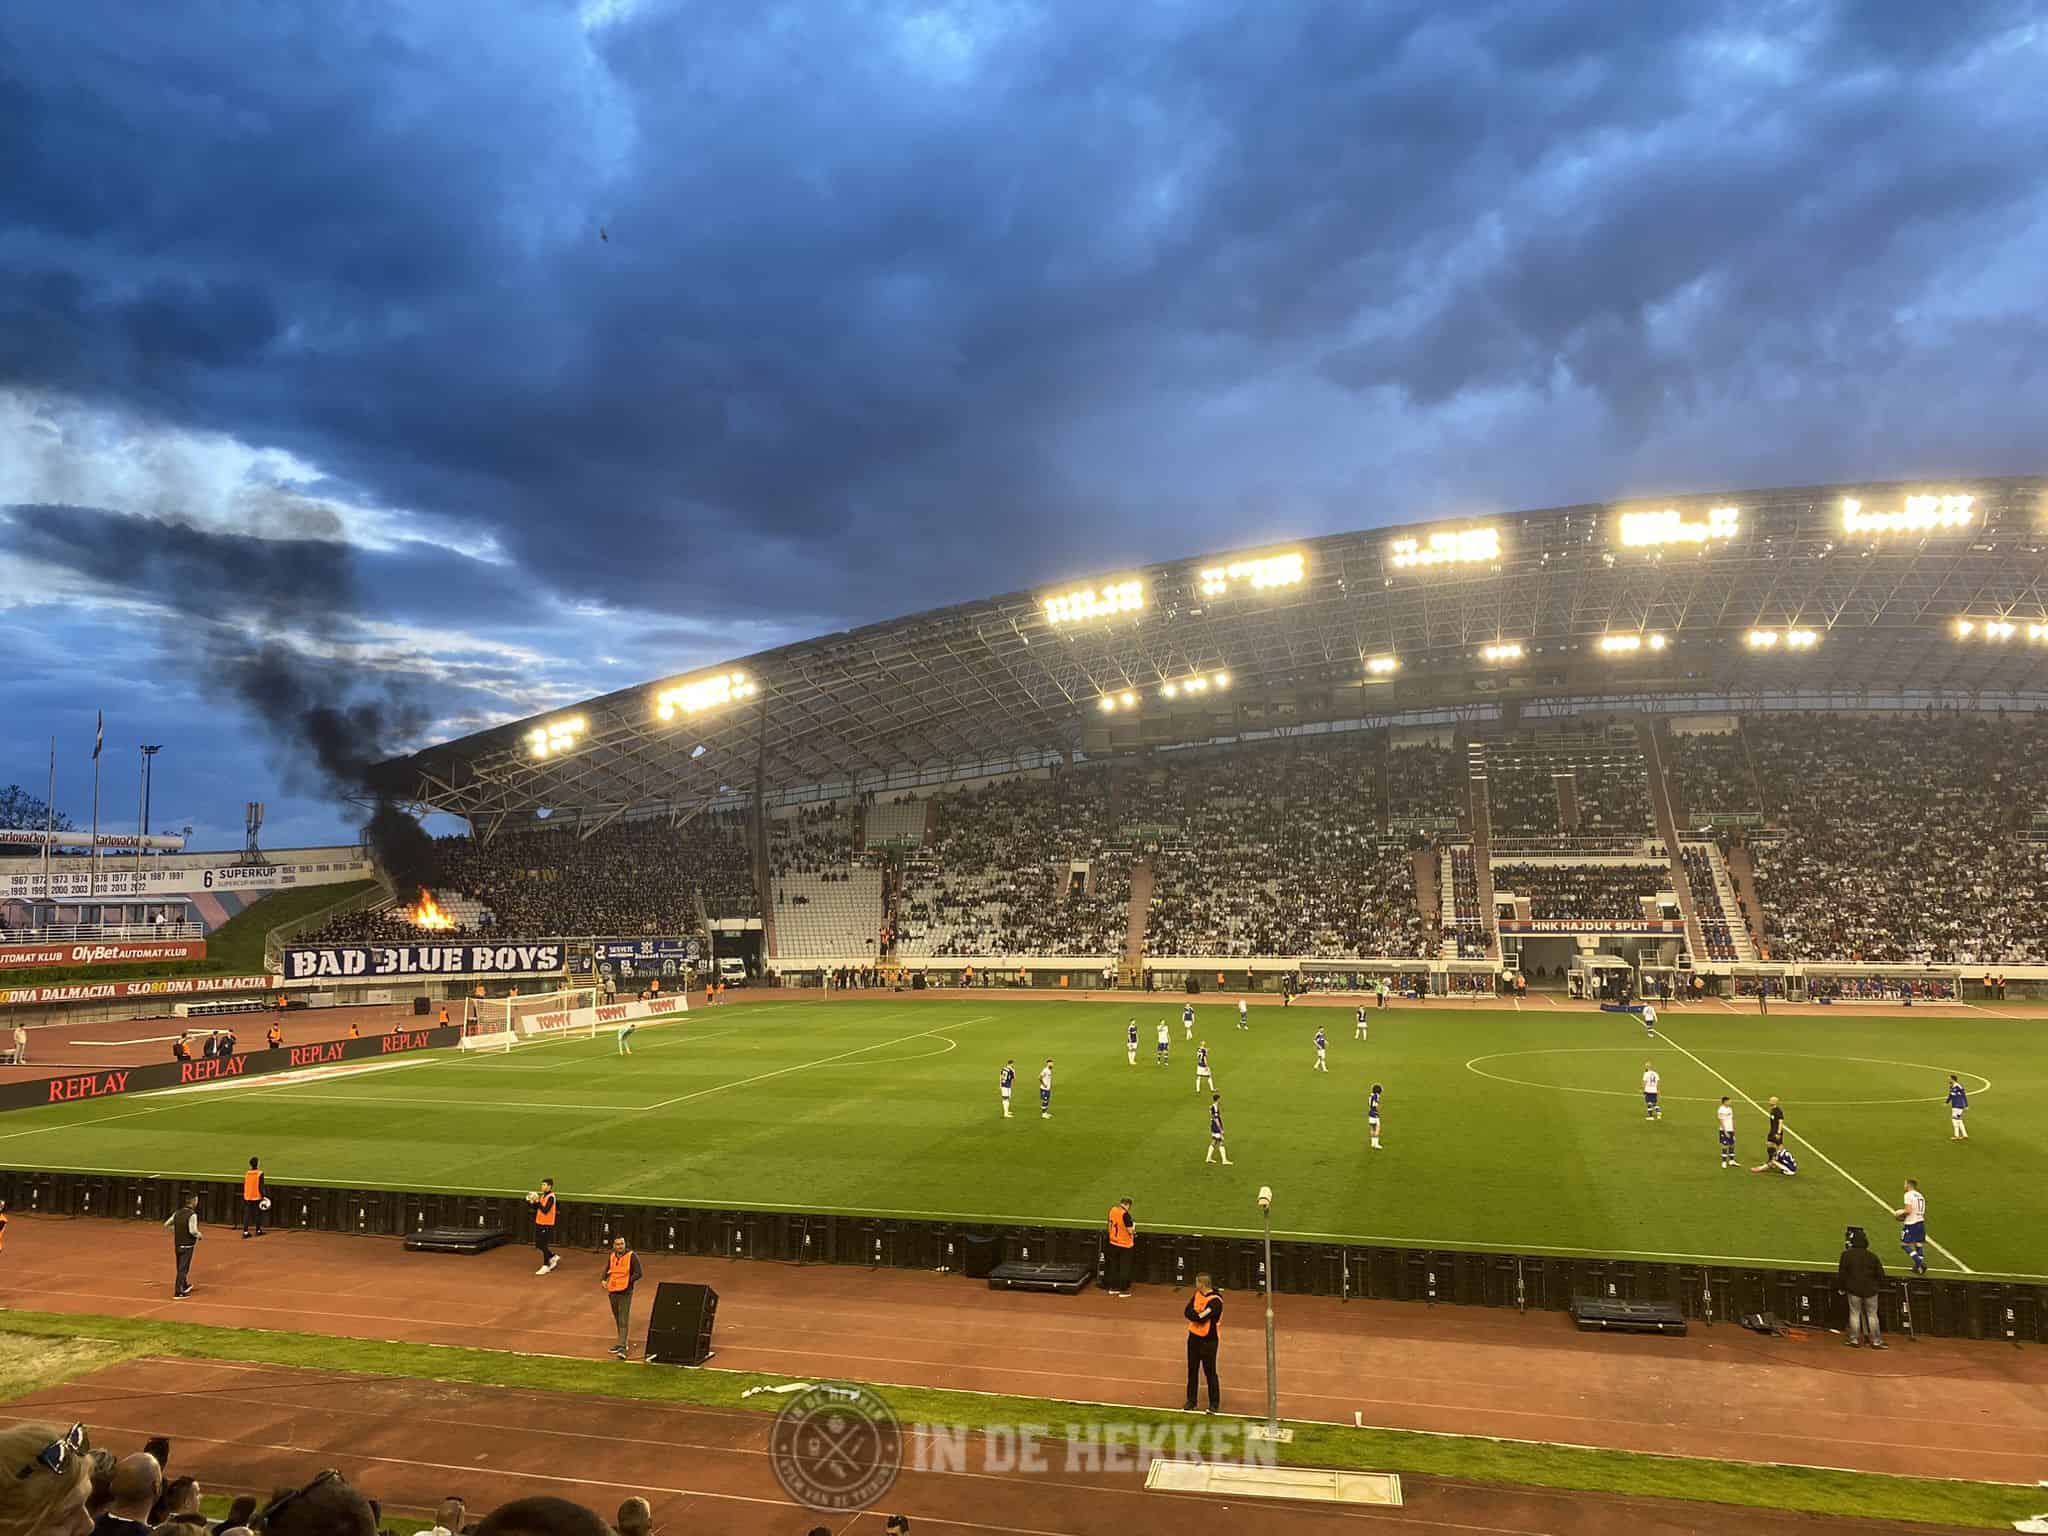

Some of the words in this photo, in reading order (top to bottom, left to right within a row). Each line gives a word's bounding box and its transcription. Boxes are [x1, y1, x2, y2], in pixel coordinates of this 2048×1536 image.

[0, 832, 46, 844] arlovačko
[11, 876, 28, 885] 1967
[72, 874, 88, 883] 1974
[94, 873, 108, 883] 976
[203, 870, 213, 888] 6
[219, 867, 276, 879] SUPERKUP
[95, 884, 108, 893] 010
[1532, 921, 1558, 931] HNK
[1560, 921, 1613, 931] HAJDUK
[1615, 921, 1649, 931] SPLIT
[37, 952, 63, 961] KLUB
[72, 946, 119, 963] OlyBet
[119, 949, 163, 959] AUTOMAT
[164, 948, 187, 957] KLUB
[292, 949, 366, 977] BAD
[375, 947, 463, 974] BLUE
[472, 945, 559, 972] BOYS
[595, 1005, 627, 1022] TOMMY
[649, 999, 676, 1014] TOMMY
[382, 1032, 430, 1054] REPLAY
[290, 1041, 345, 1066] REPLAY
[181, 1055, 248, 1083] REPLAY
[48, 1071, 129, 1102] REPLAY
